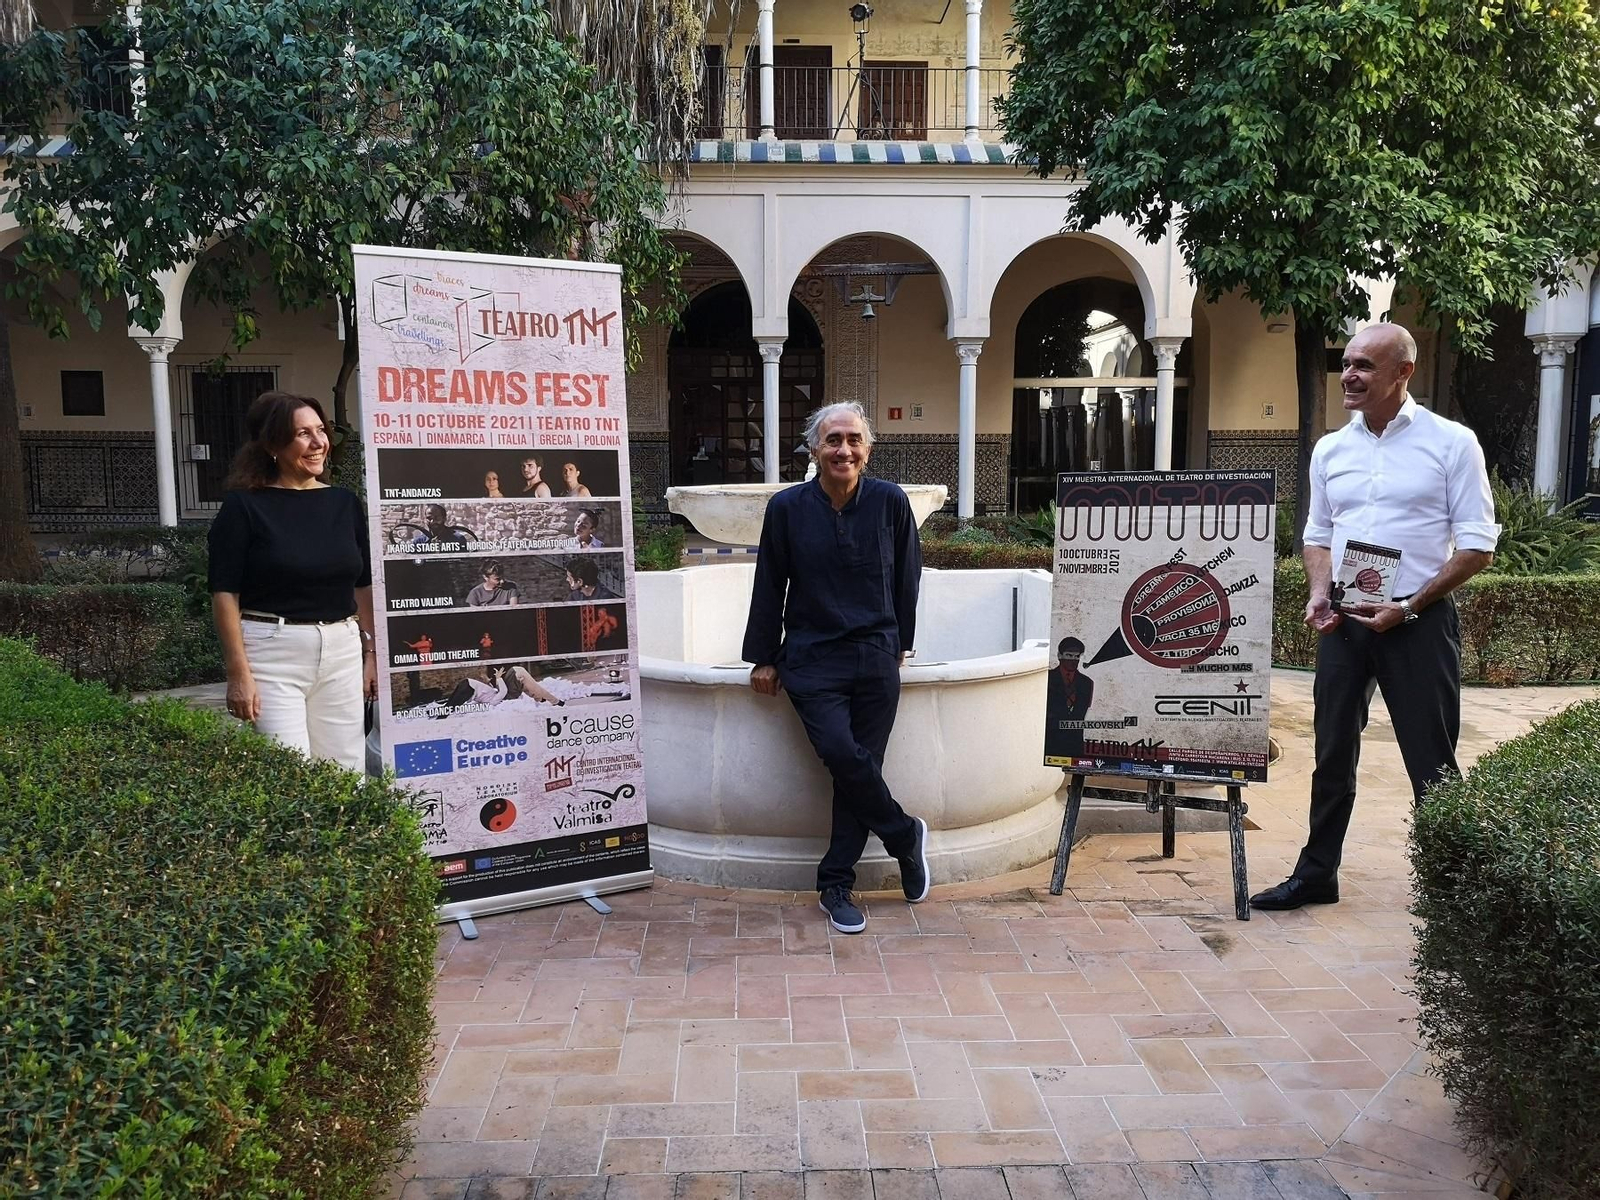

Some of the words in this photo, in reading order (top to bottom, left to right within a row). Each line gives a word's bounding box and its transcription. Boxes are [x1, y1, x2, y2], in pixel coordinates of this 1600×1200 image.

[434, 272, 465, 287] traces
[412, 282, 450, 301] dreams
[478, 309, 559, 338] TEATRO
[563, 308, 617, 347] TNT
[378, 367, 527, 406] DREAMS
[535, 372, 609, 408] FEST
[374, 413, 411, 428] 10-11
[417, 414, 486, 429] OCTUBRE
[491, 416, 526, 430] 2021
[537, 416, 590, 430] TEATRO
[595, 418, 620, 432] TNT
[374, 430, 413, 443] ESPAÑA
[427, 432, 485, 445] DINAMARCA
[498, 433, 527, 445] ITALIA
[540, 434, 572, 446] GRECIA
[584, 434, 620, 446] POLONIA
[1217, 471, 1272, 479] INVESTIGACIÓN
[384, 488, 442, 498] TNT-ANDANZAS
[387, 543, 415, 554] IKARUS
[416, 542, 440, 552] STAGE
[441, 542, 460, 552] ARTS
[467, 541, 497, 551] NORDISK
[500, 539, 576, 551] TEATERLABORATORIUM
[391, 599, 420, 609] TEATRO
[421, 596, 453, 607] VALMISA
[1188, 627, 1200, 636] 35
[394, 654, 419, 664] OMMA
[419, 652, 446, 662] STUDIO
[447, 649, 479, 660] THEATRE
[428, 706, 454, 718] DANCE
[455, 703, 490, 715] COMPANY
[1155, 695, 1262, 715] CENIT
[1060, 721, 1125, 729] MAIAKOVSKI
[456, 734, 528, 753] Creative
[547, 734, 583, 750] dance
[586, 730, 635, 746] company
[1085, 739, 1128, 756] TEATRO
[457, 750, 528, 769] Europe
[544, 755, 576, 779] TNT
[576, 758, 596, 768] CENTRO
[597, 754, 636, 765] INTERNACIONAL
[623, 761, 642, 770] TEATRAL
[476, 782, 517, 791] NORDISK
[567, 799, 612, 815] teatro
[554, 812, 612, 830] Valmisa
